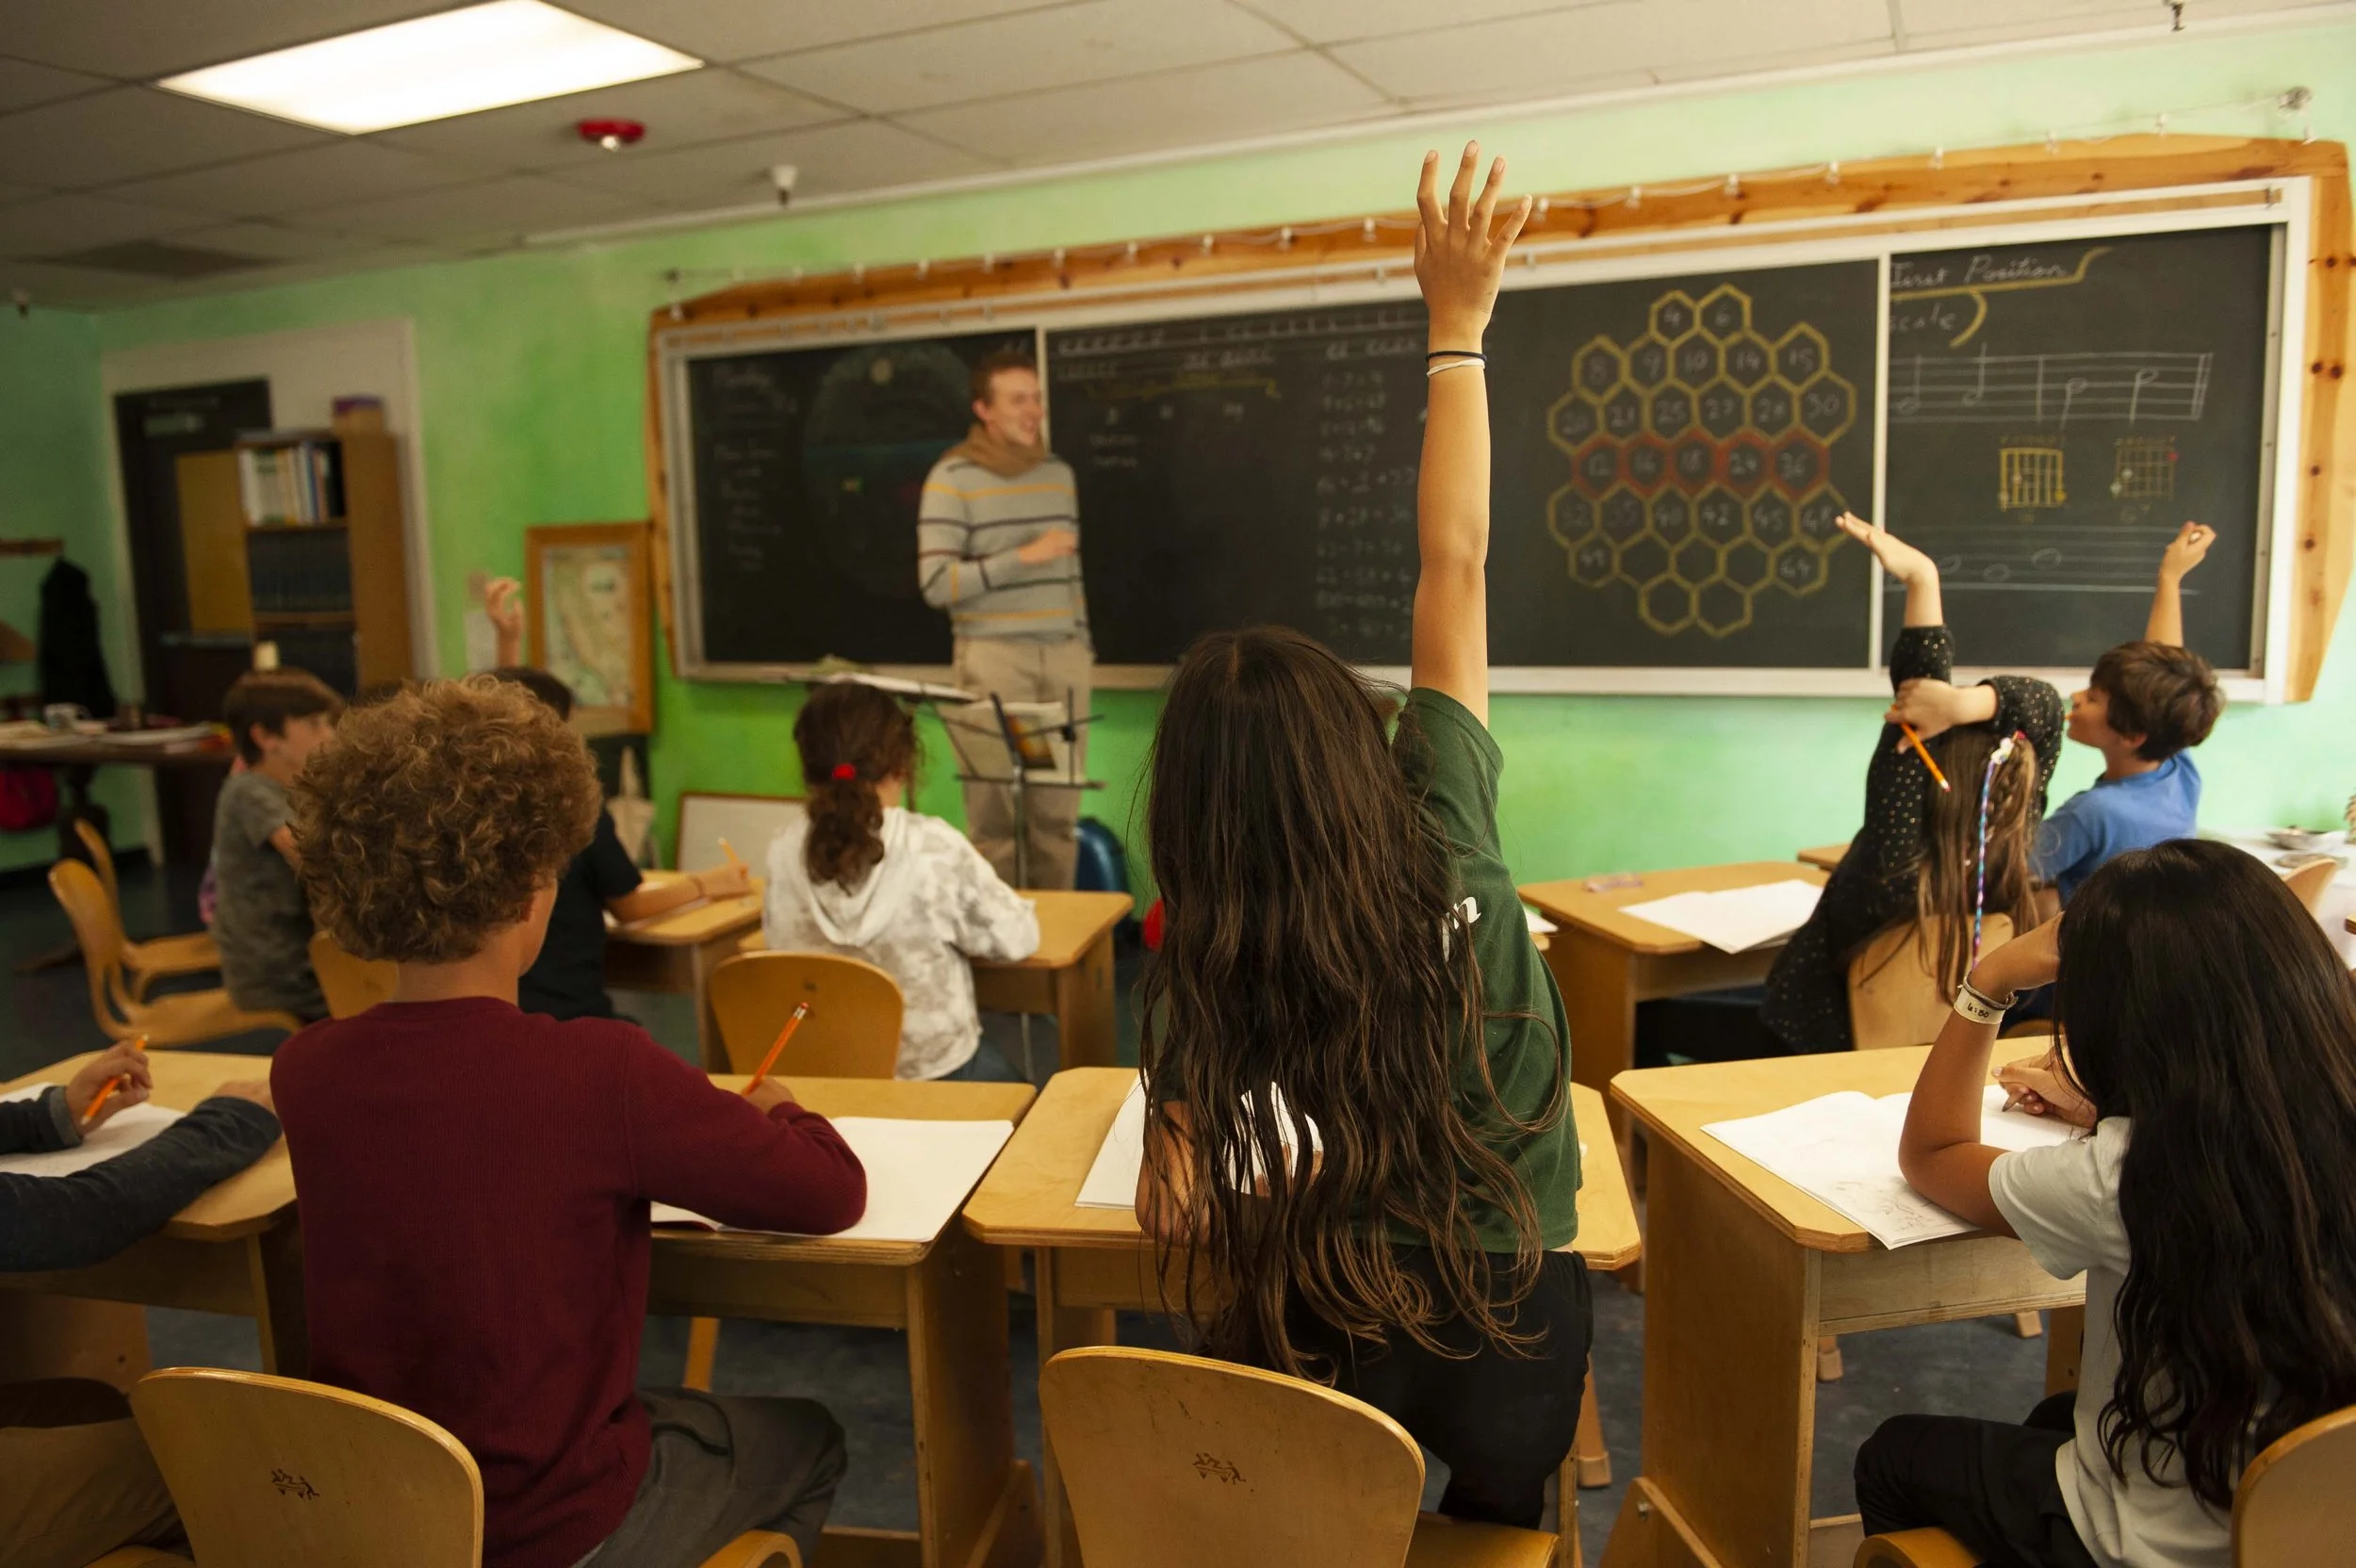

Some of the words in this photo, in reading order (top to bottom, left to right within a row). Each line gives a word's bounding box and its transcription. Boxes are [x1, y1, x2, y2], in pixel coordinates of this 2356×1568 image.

[1964, 254, 2068, 285] Position
[1662, 305, 1681, 327] 4
[1640, 349, 1661, 381] 9
[1681, 349, 1710, 374] 10
[1733, 350, 1761, 371] 14
[1786, 347, 1814, 373] 15
[1609, 405, 1635, 427] 21
[1653, 400, 1686, 424] 25
[1703, 398, 1738, 420] 27
[1804, 392, 1841, 420] 30
[1702, 500, 1729, 527] 42
[1752, 505, 1782, 532] 45
[1780, 556, 1811, 580] 64
